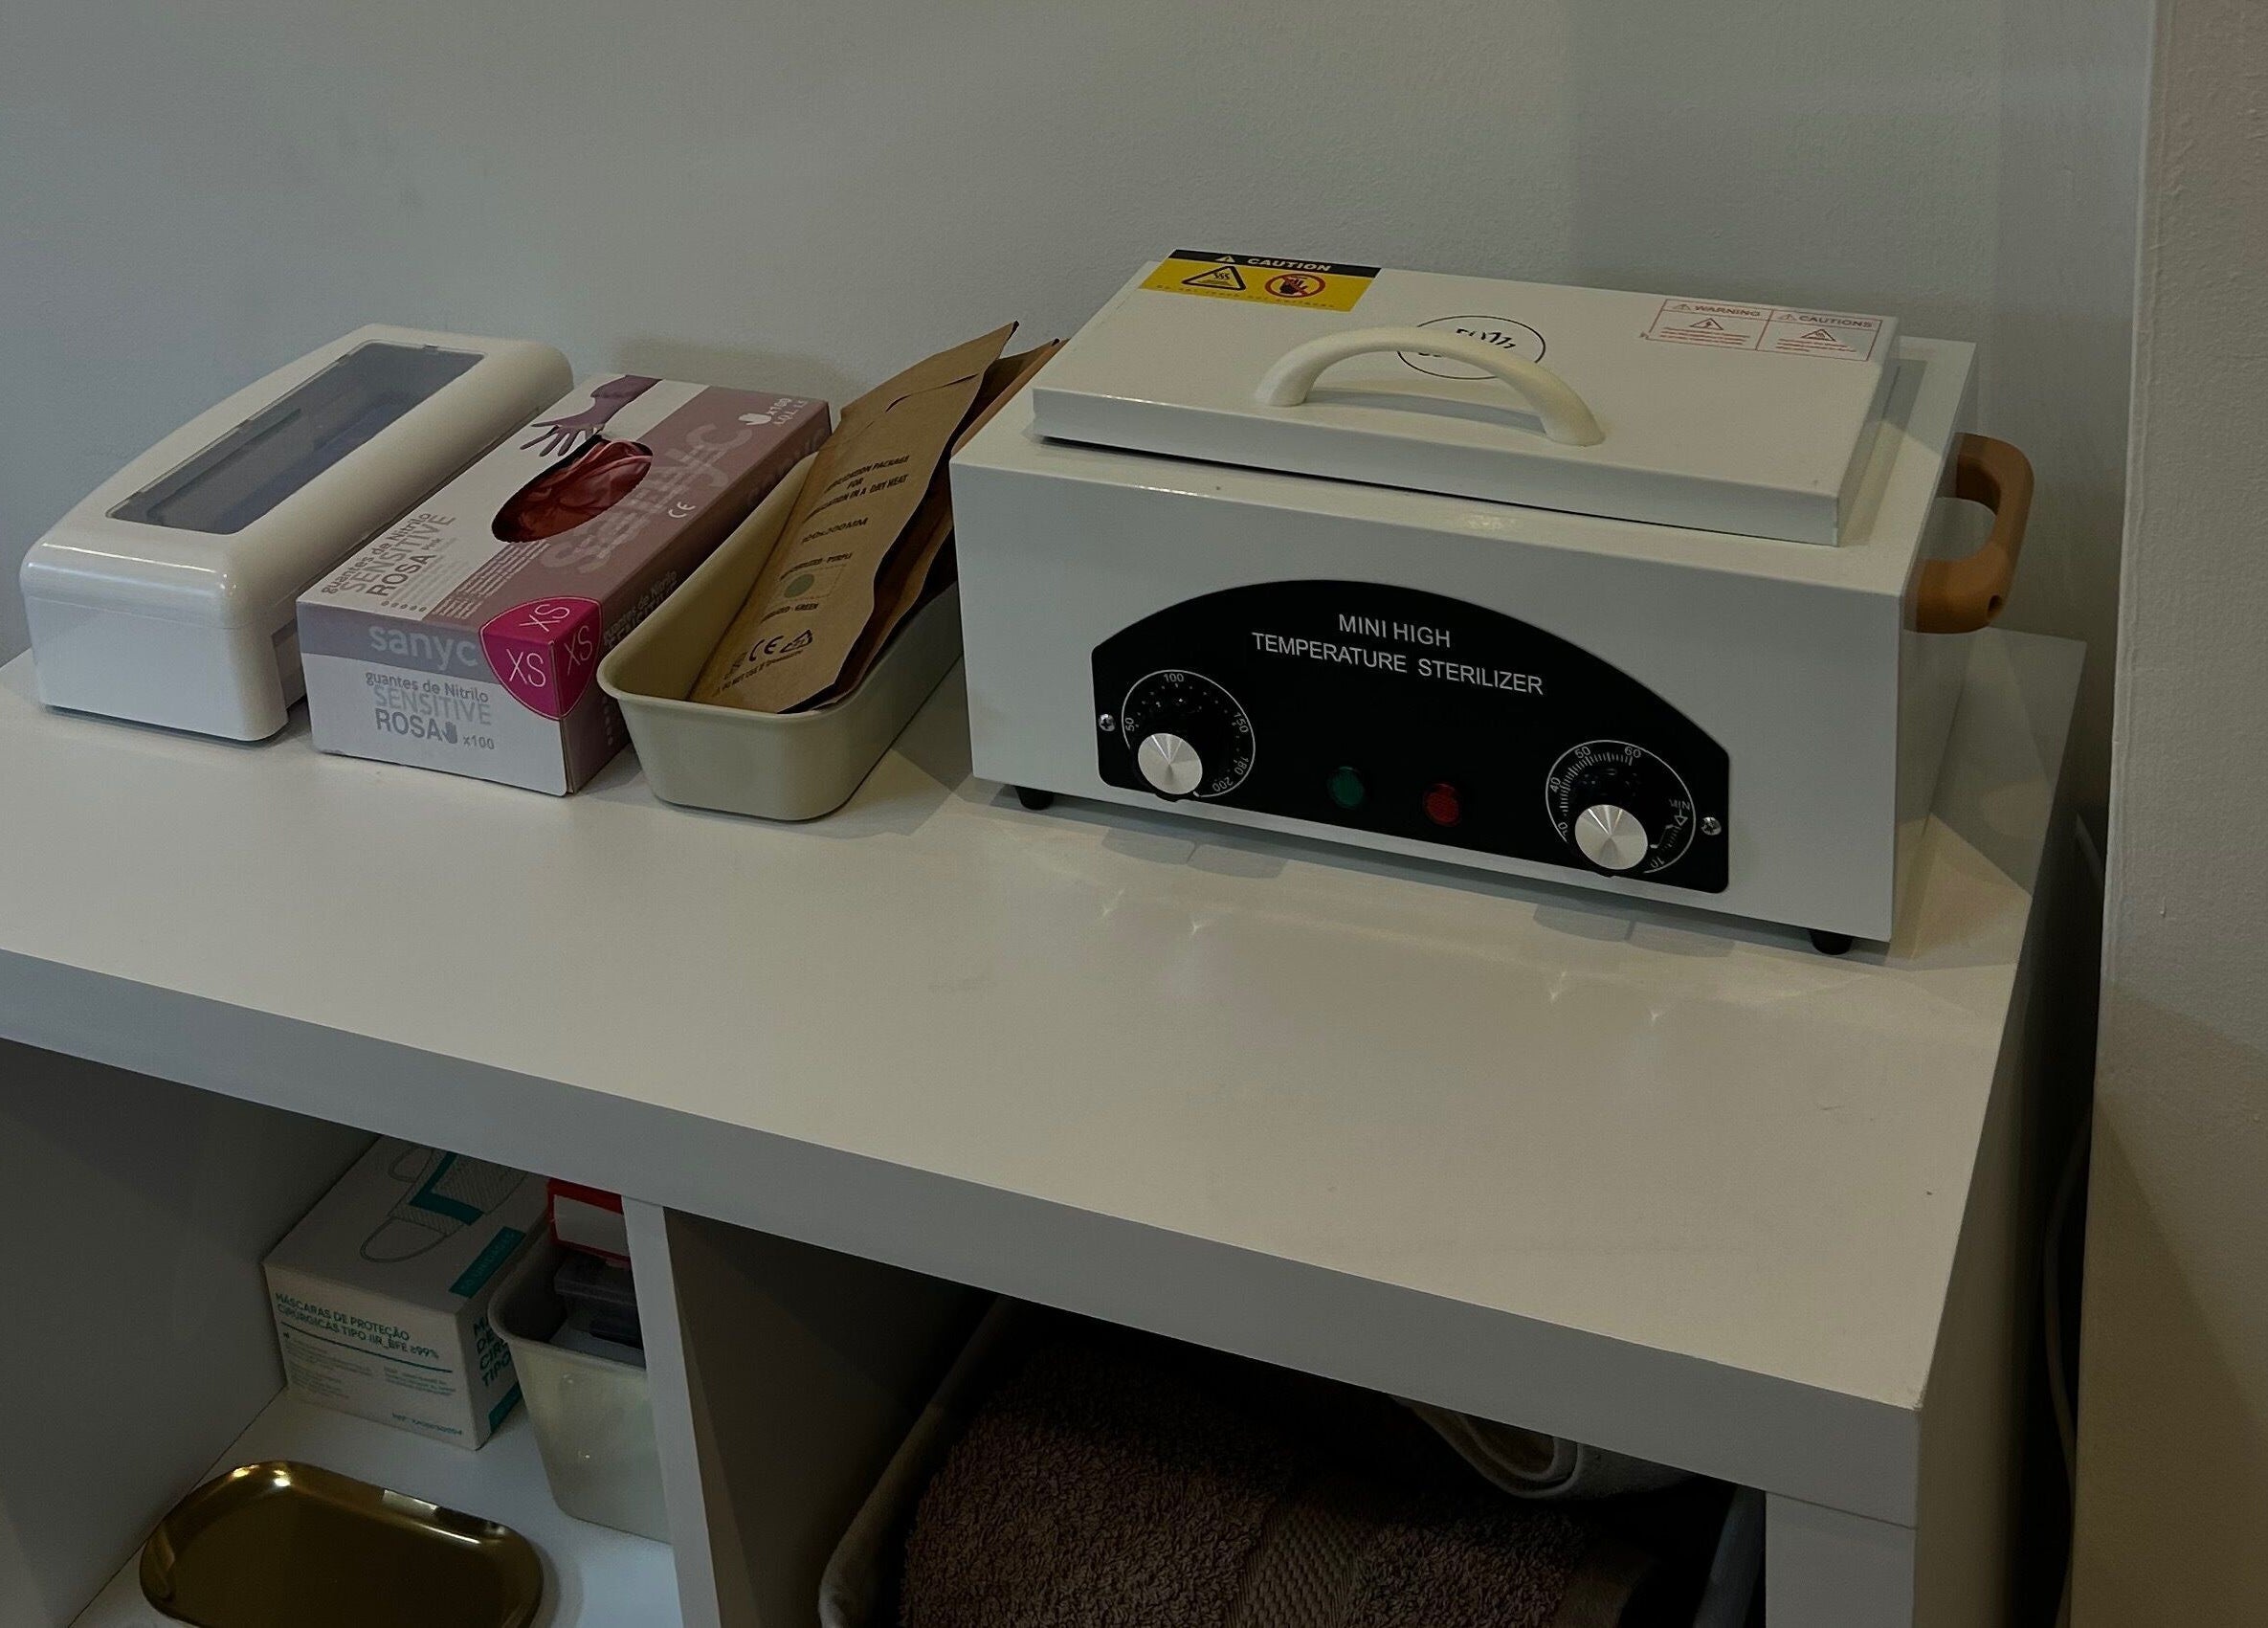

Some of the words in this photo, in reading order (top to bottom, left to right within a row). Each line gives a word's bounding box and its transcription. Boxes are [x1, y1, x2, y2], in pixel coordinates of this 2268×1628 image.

[1248, 257, 1331, 272] CAUTION
[1695, 305, 1761, 317] WARNING
[1798, 315, 1873, 328] CAUTIONS
[321, 556, 374, 594] guantes
[371, 543, 392, 556] de
[390, 513, 432, 542] Nitrilo
[340, 514, 456, 592] SENSITIVE
[366, 553, 436, 596] ROSA
[519, 604, 570, 633] XS
[1339, 613, 1387, 638] MINI
[1393, 622, 1451, 648] HIGH
[368, 625, 478, 671] sanyc
[564, 625, 592, 677] XS
[506, 648, 546, 687] XS
[1163, 673, 1185, 682] 100
[1251, 632, 1407, 673] TEMPERATURE
[1417, 658, 1544, 695] STERILIZER
[366, 672, 418, 690] guantes
[423, 680, 440, 695] de
[445, 682, 489, 703] Nitrilo
[374, 685, 492, 725] SENSITIVE
[375, 707, 444, 742] ROSA
[463, 735, 495, 750] x100
[1125, 717, 1135, 732] 50
[1234, 712, 1249, 733] 150
[1234, 756, 1249, 775] 180
[1574, 746, 1591, 758] 50
[1624, 746, 1641, 758] 60
[1212, 776, 1234, 792] 200
[1548, 776, 1561, 793] 40
[1668, 798, 1691, 811] MIN
[334, 1311, 347, 1324] DE
[350, 1317, 410, 1341] PROTEÇÃO
